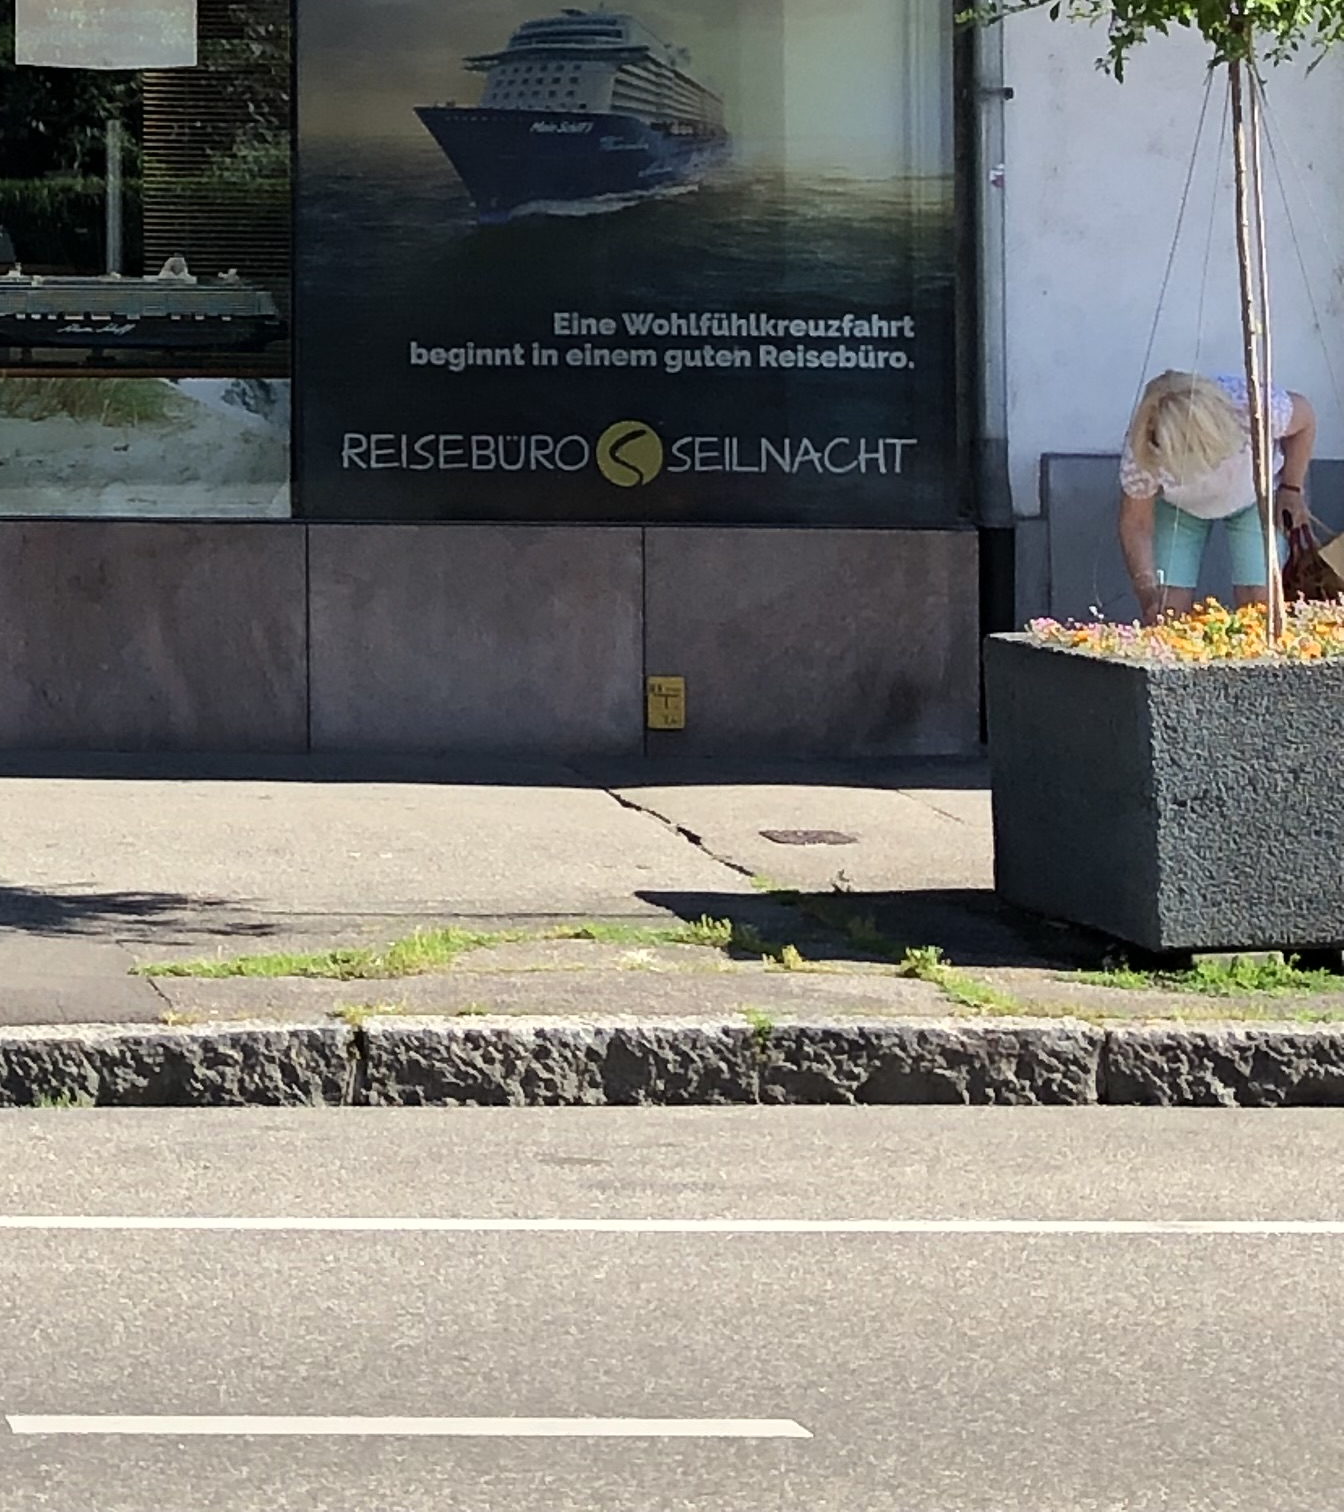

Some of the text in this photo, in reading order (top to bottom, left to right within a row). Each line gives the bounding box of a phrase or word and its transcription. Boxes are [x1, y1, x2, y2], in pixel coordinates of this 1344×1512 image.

[554, 312, 915, 338] Eine Wohlfühlkreuzfahrt
[410, 342, 915, 373] beginnt in einem guten Reisebüro.
[342, 433, 918, 474] REISEBÜRO SEILNACHT
